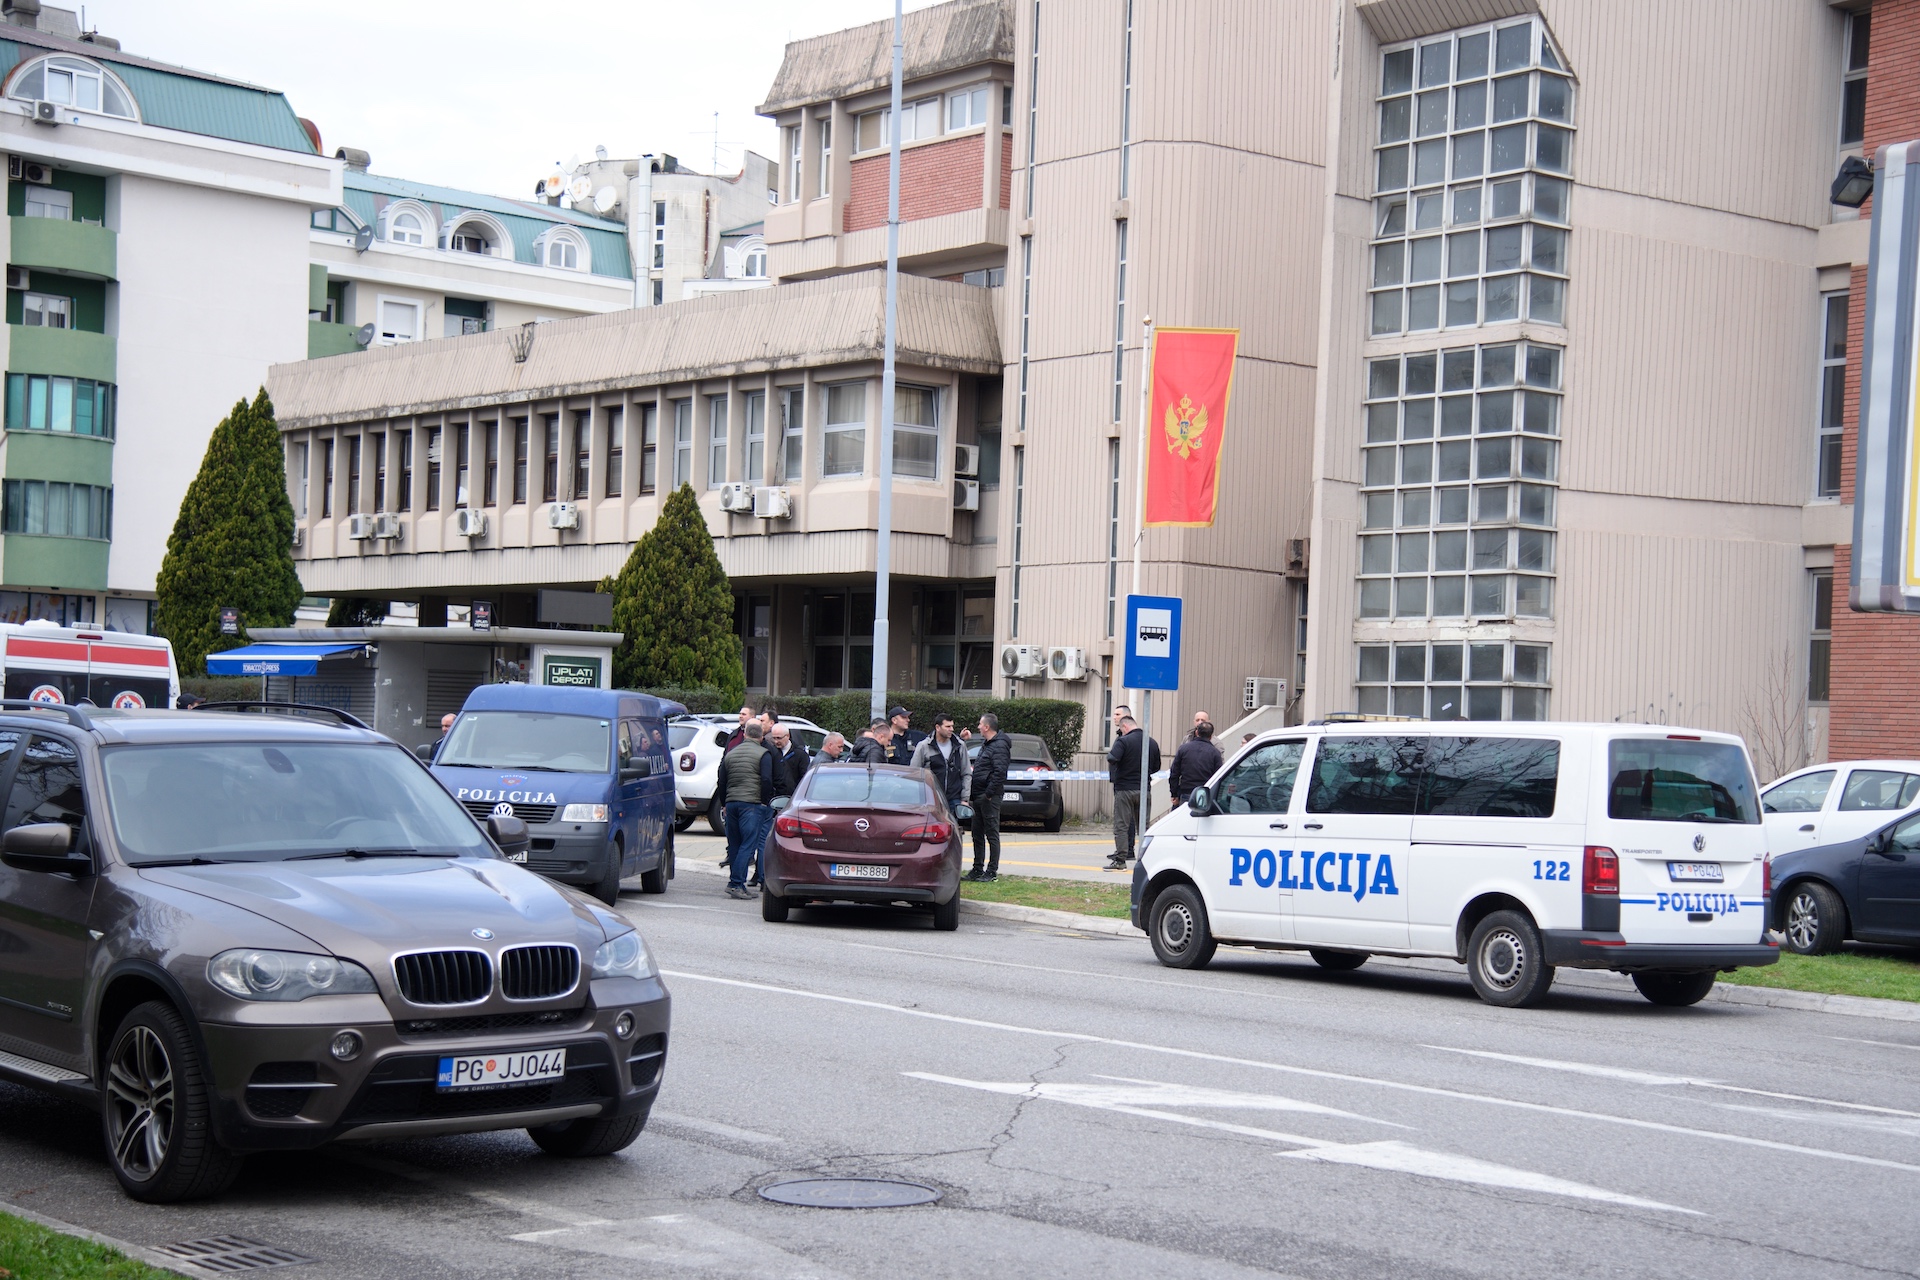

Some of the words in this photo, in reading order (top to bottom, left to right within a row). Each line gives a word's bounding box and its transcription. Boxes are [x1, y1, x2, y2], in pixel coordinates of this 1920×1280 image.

[266, 664, 280, 672] PRESS
[552, 667, 593, 677] UPLATI
[552, 676, 592, 685] DEPOZIT
[457, 787, 557, 803] POLICIJA
[837, 865, 850, 875] PG
[856, 866, 888, 877] HS888
[1229, 848, 1399, 903] POLICIJA
[1533, 860, 1570, 881] 122
[1678, 864, 1685, 876] P
[1693, 865, 1722, 878] PG424
[1656, 892, 1739, 917] POLICIJA
[439, 1073, 452, 1082] MNE
[455, 1060, 484, 1082] PG
[499, 1052, 562, 1079] JJ044
